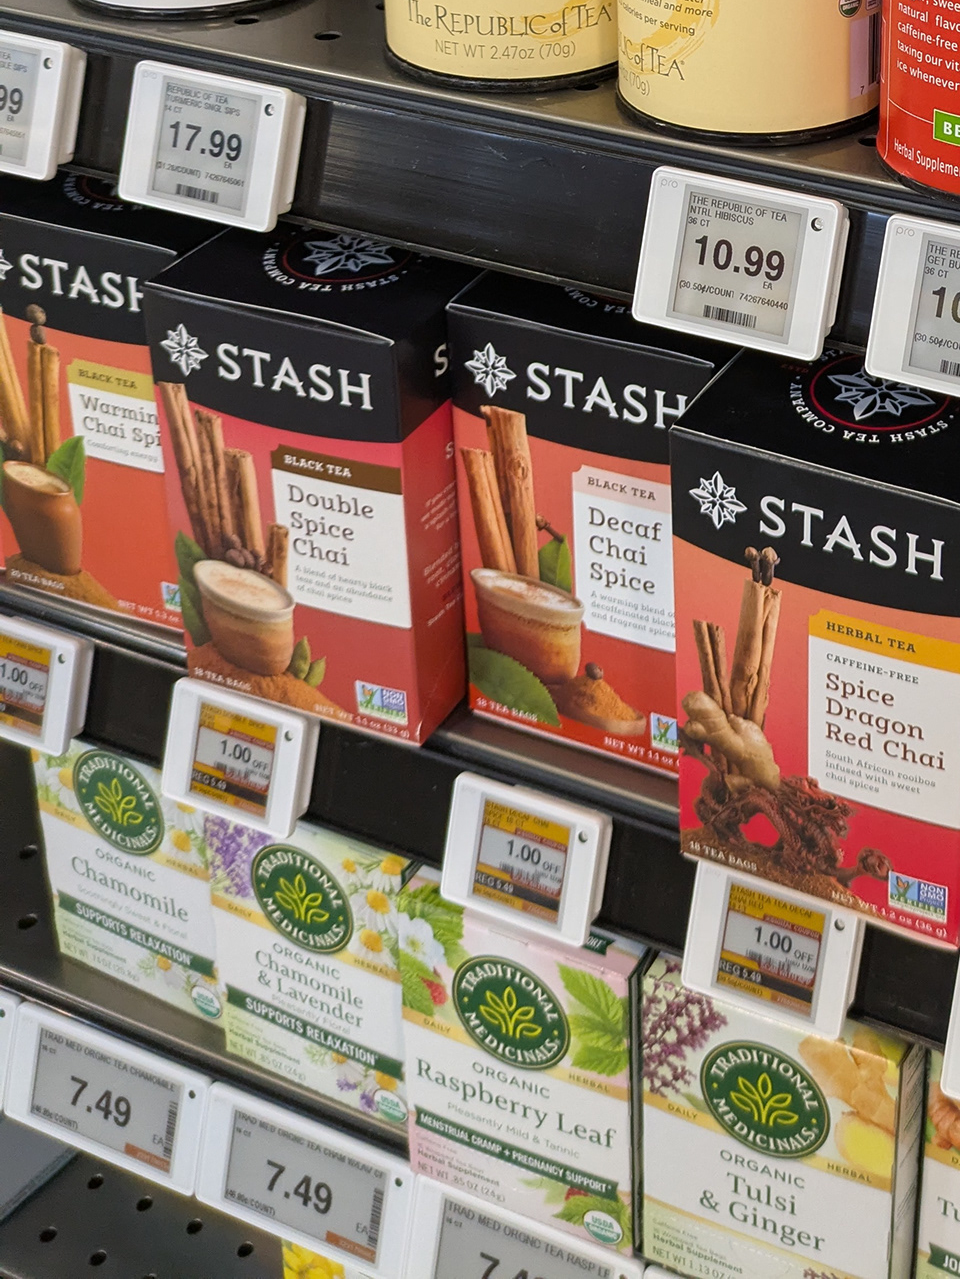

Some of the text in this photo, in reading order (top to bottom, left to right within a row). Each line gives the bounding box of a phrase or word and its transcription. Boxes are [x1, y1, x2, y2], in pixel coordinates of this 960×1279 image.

[435, 39, 576, 60] NET WT 2.47oz (70g)
[170, 121, 242, 162] 17.99
[690, 205, 754, 226] NTRL HIBISCUS
[695, 235, 785, 281] 10.99
[217, 342, 374, 410] STASH
[526, 361, 688, 429] STASH
[284, 454, 352, 477] BLACK TEA
[287, 483, 374, 519] Double
[587, 476, 656, 501] BLACK TEA
[290, 511, 354, 542] Spice
[588, 506, 662, 542] Decaf
[759, 495, 945, 581] STASH
[293, 538, 350, 566] Chai
[590, 535, 648, 566] Chai
[590, 561, 656, 595] Spice
[826, 621, 917, 653] HERBAL TEA
[826, 653, 919, 684] CAFFEINE-FREE
[826, 672, 895, 707] Spice
[826, 697, 925, 740] Dragon
[221, 740, 252, 763] 1.00
[826, 722, 946, 771] Red Chai
[95, 847, 156, 882] ORGANIC
[507, 839, 542, 865] 1.00
[71, 857, 189, 922] Chamomile
[76, 902, 127, 936] SUPPORTS
[755, 926, 792, 953] 1.00
[255, 950, 364, 1009] Chamomile
[258, 971, 364, 1028] & Lavender
[472, 1061, 551, 1100] ORGANIC
[70, 1075, 132, 1128] 7.49
[416, 1057, 617, 1149] Raspberry Leaf
[266, 1159, 333, 1215] 7.49
[720, 1149, 806, 1189] ORGANIC
[727, 1172, 797, 1216] Tulsi
[700, 1190, 826, 1251] & Ginger
